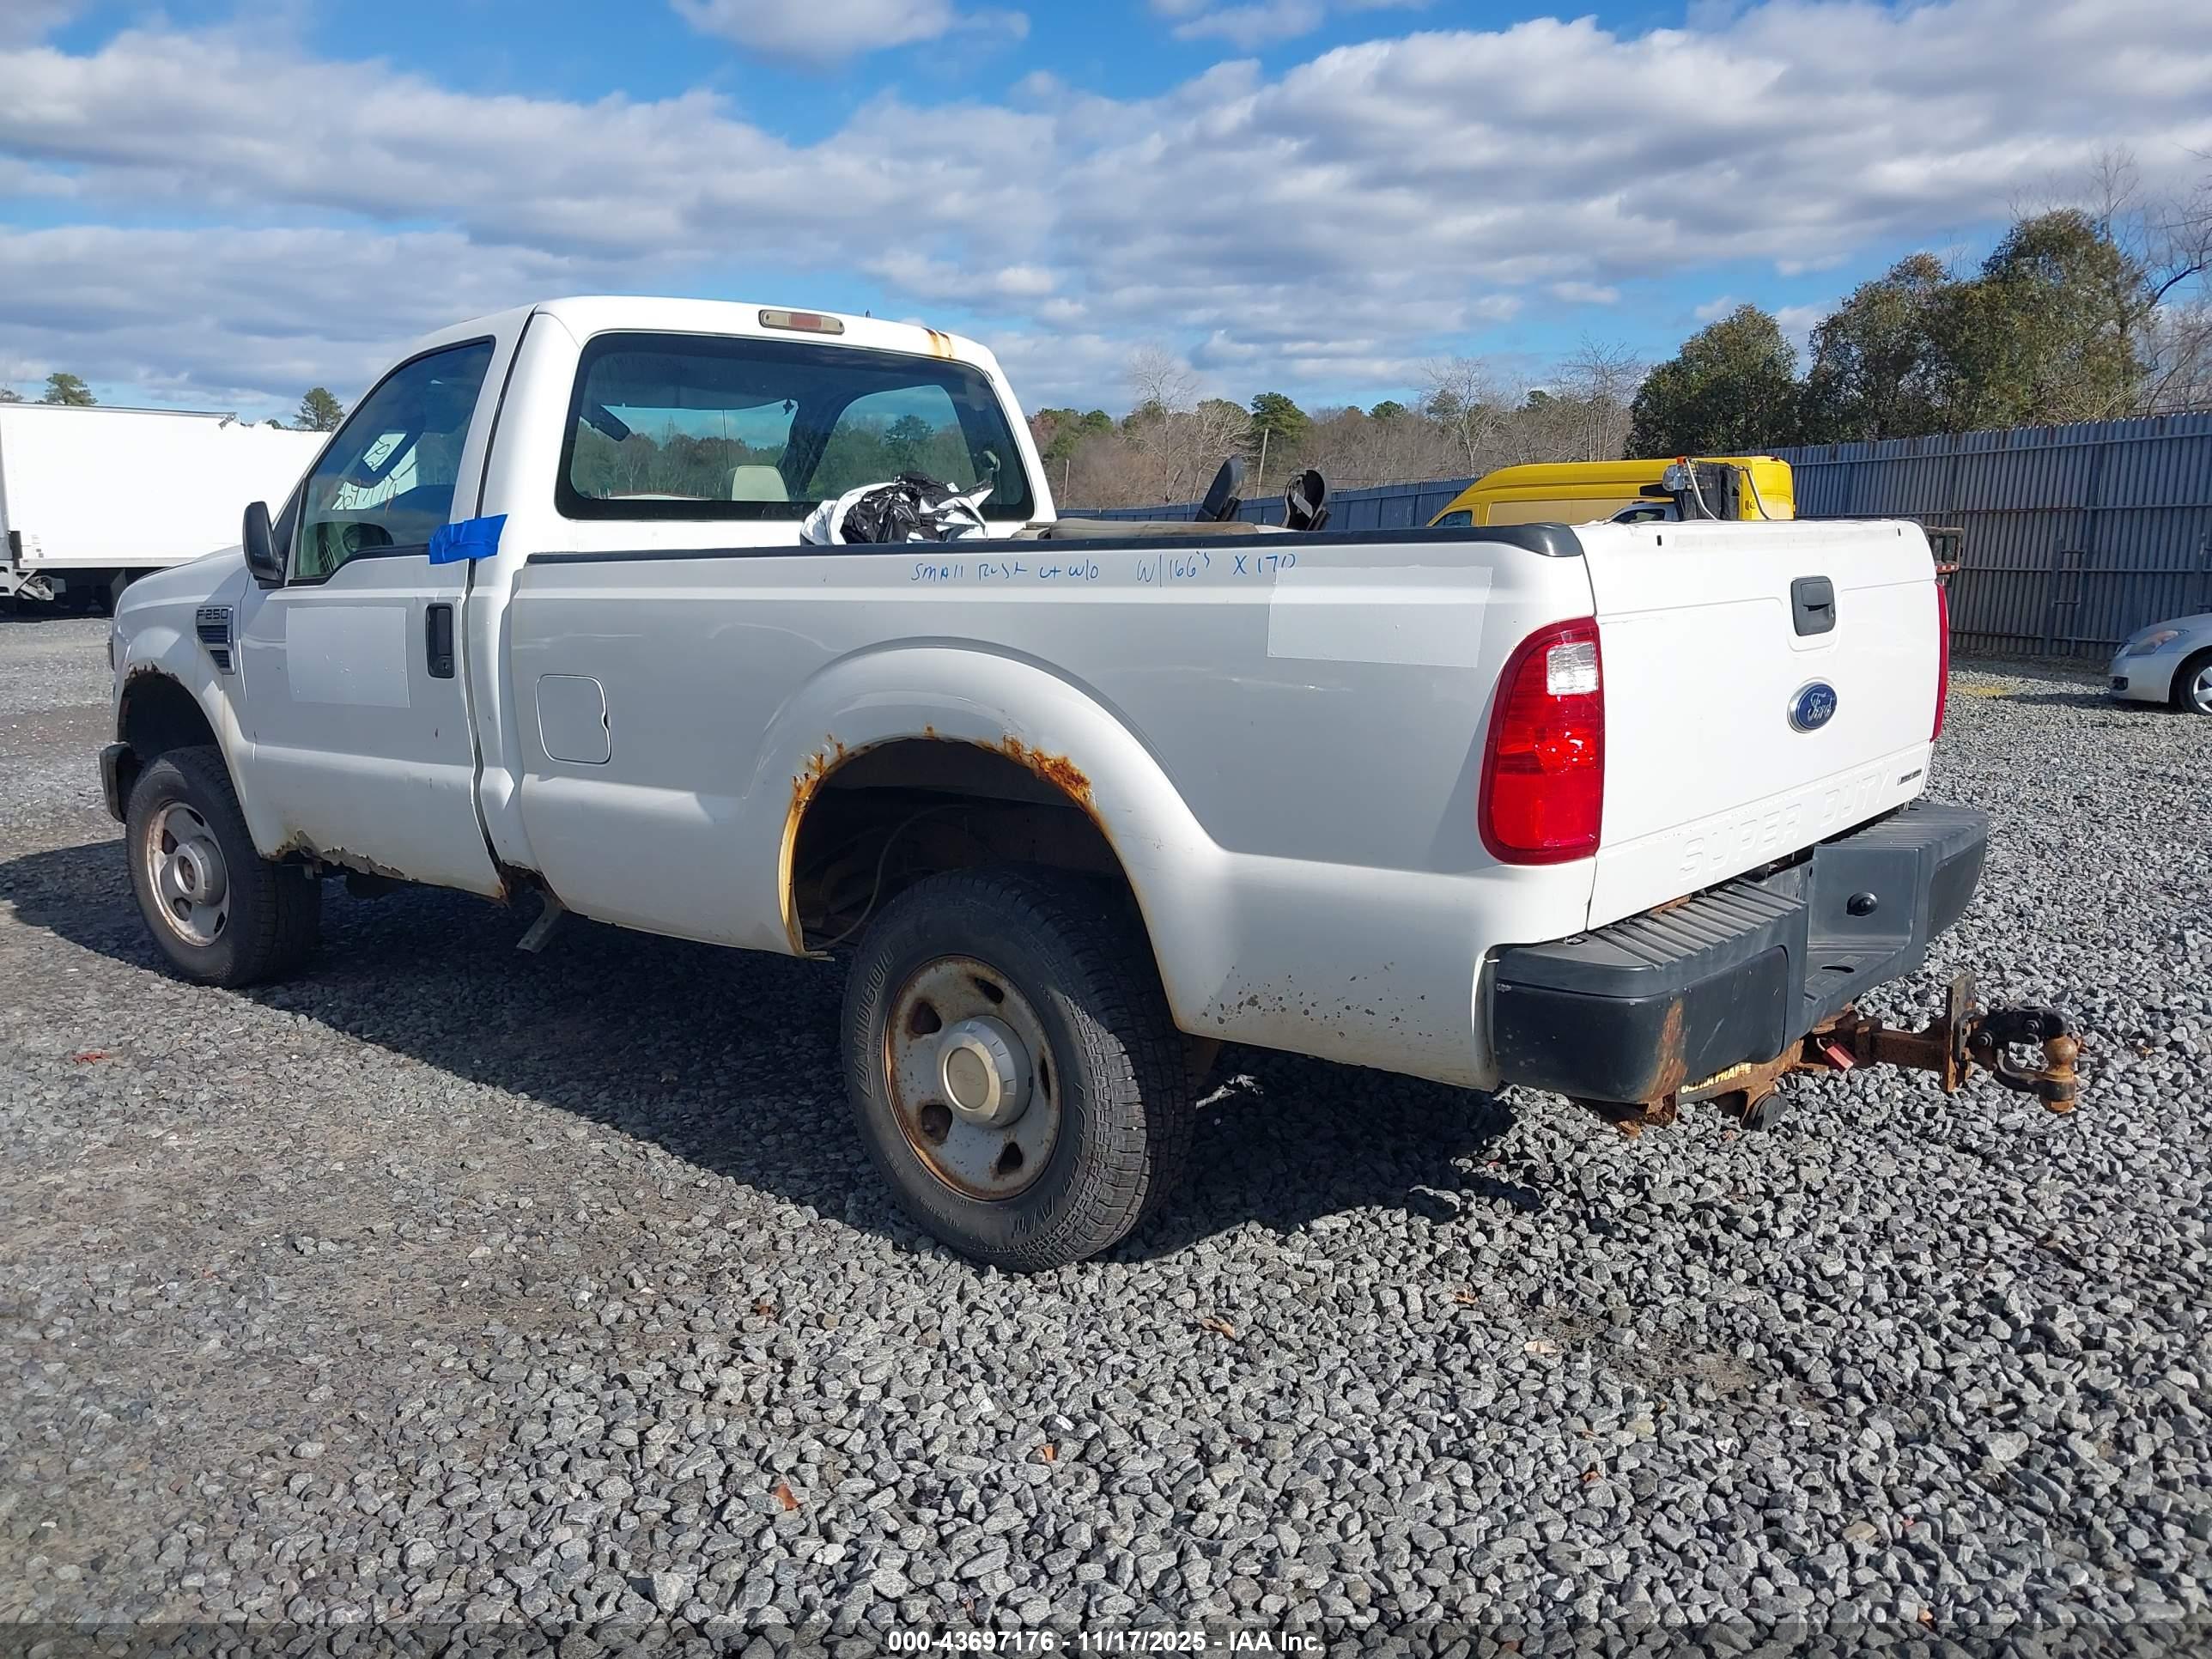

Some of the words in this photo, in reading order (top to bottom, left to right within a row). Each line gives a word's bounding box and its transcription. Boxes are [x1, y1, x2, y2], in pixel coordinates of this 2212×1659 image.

[1808, 692, 1832, 722] Ford
[1679, 803, 1803, 883] SUPER
[1820, 769, 1891, 829] DUTY
